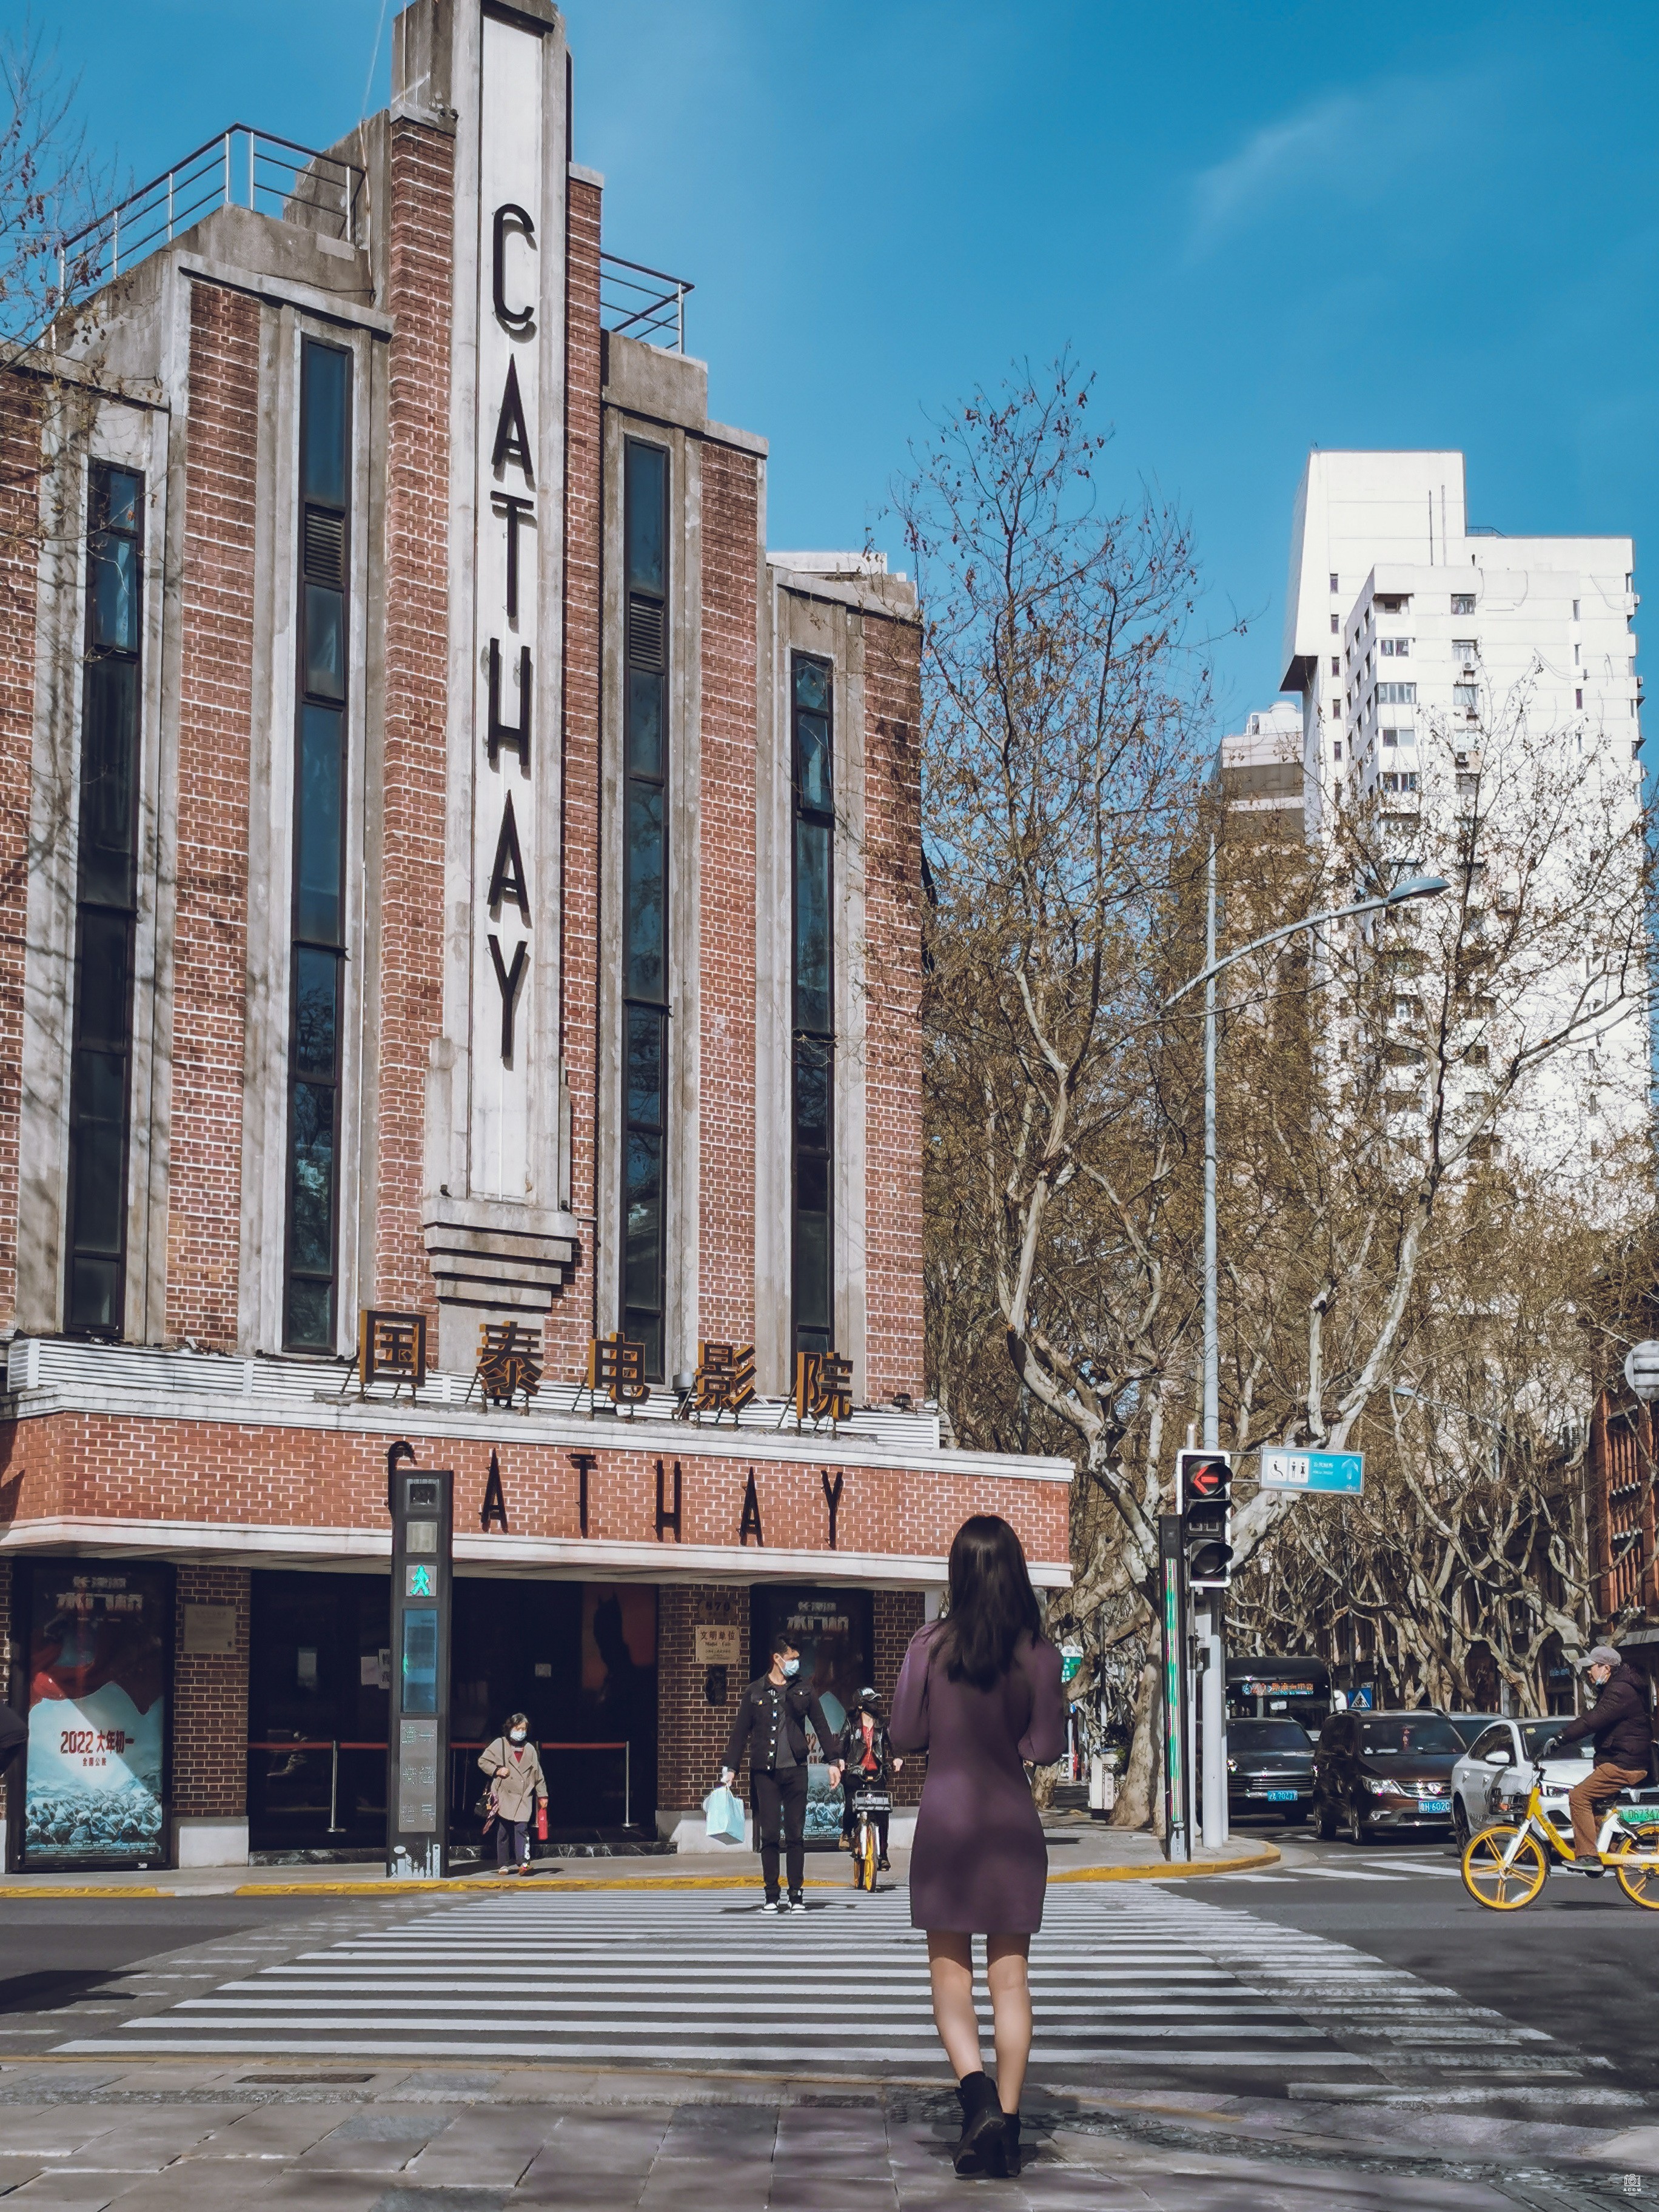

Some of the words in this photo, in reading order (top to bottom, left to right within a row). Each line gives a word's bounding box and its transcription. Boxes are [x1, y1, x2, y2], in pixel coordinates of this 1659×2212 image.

[486, 203, 536, 1061] CATHAY
[360, 1309, 854, 1421] 国泰电影院
[60, 1731, 93, 1754] 2022
[96, 1729, 135, 1754] 大年初一
